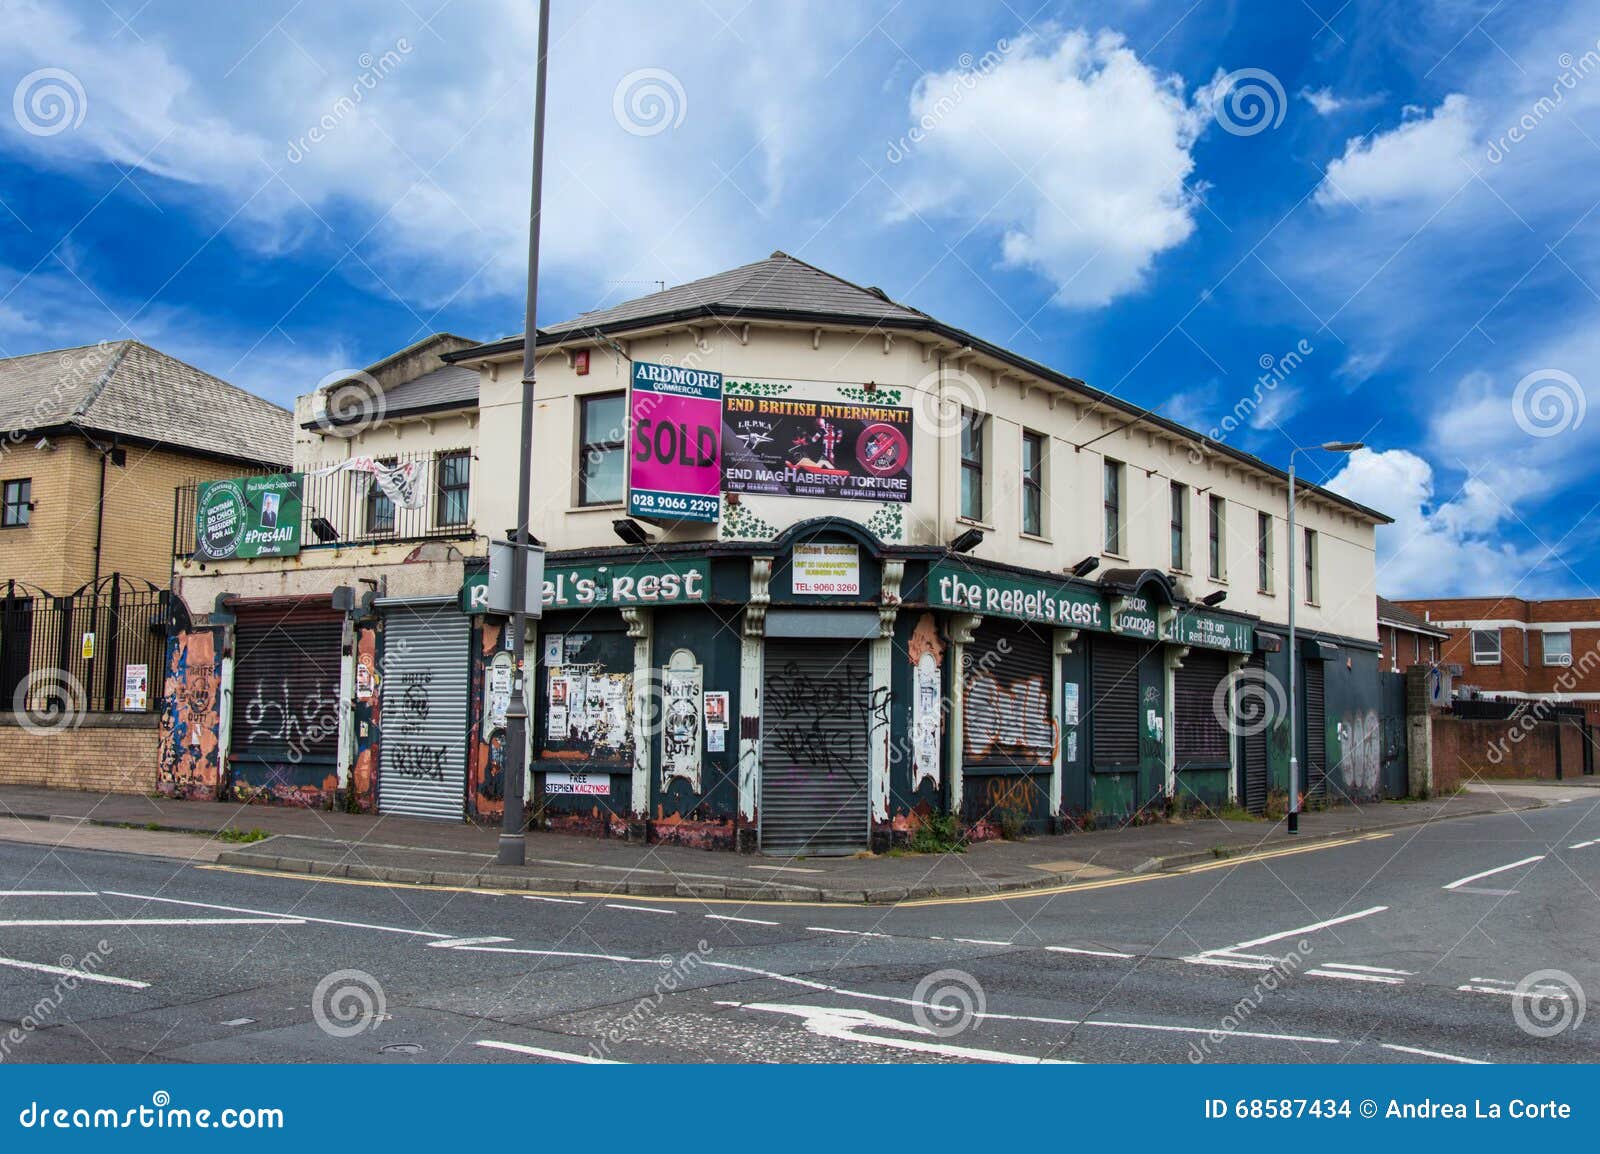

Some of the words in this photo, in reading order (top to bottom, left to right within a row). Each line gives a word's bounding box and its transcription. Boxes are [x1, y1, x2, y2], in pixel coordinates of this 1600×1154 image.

[636, 364, 720, 390] ARDMORE
[653, 382, 702, 396] COMMERCIAL
[727, 397, 755, 413] END
[758, 399, 816, 417] BRITISH
[820, 403, 909, 423] INTERNMENT!
[635, 417, 717, 468] SOLD
[726, 468, 753, 480] END
[850, 475, 908, 490] TORTURE
[632, 494, 655, 507] 028
[657, 496, 687, 510] 9066
[690, 499, 718, 513] 2299
[207, 515, 216, 524] DO
[207, 516, 237, 533] PRESIDENT
[211, 530, 224, 541] FOR
[224, 526, 235, 537] ALL
[245, 526, 293, 544] #Pres4All
[471, 571, 596, 608] Rel's
[612, 569, 703, 602] Rest
[795, 583, 811, 591] TEL:
[813, 583, 835, 591] 9060
[836, 583, 857, 591] 3260
[939, 574, 982, 608] the
[1059, 599, 1101, 627] Rest
[545, 783, 574, 792] STEPHEN
[569, 774, 588, 783] FREE
